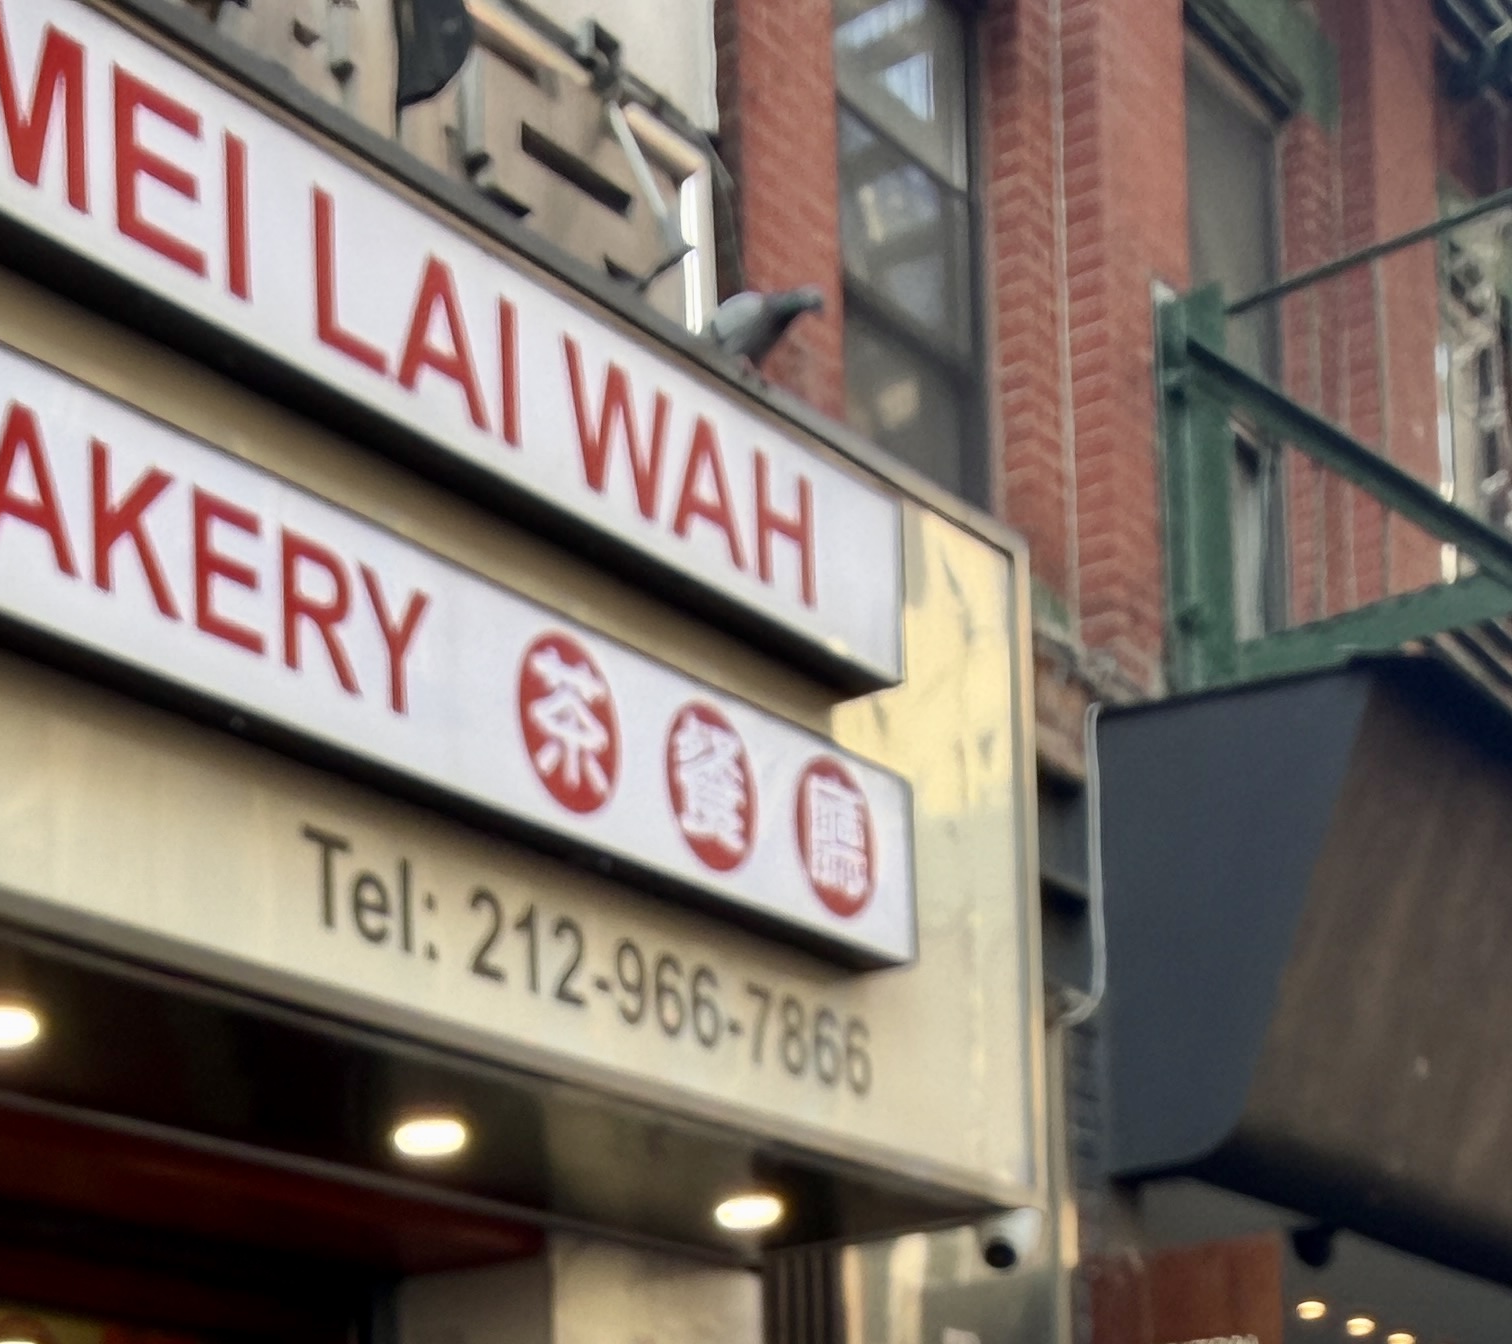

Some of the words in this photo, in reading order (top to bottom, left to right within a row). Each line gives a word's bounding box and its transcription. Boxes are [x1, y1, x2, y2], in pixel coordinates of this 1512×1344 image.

[312, 186, 520, 447] LAI
[563, 334, 816, 609] WAH
[299, 822, 440, 963] Tel:
[468, 883, 875, 1099] 212-966-7866
